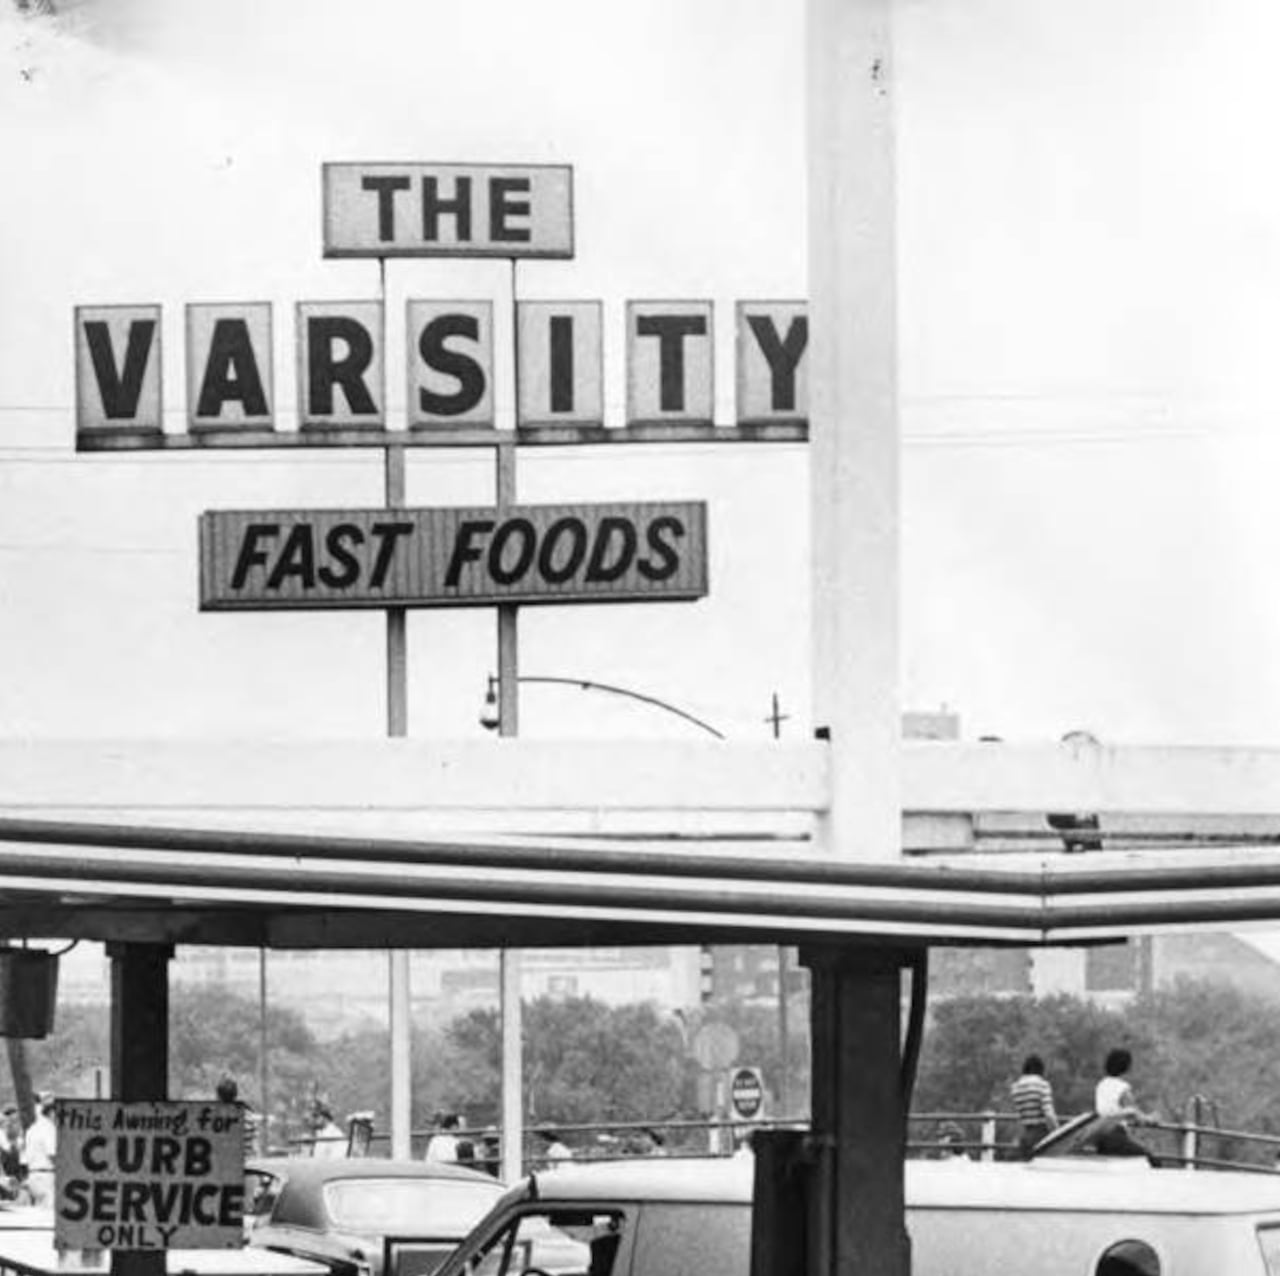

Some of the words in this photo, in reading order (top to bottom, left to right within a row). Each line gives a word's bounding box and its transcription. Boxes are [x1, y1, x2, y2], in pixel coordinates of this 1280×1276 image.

[360, 175, 532, 243] THE
[82, 313, 808, 417] VARSITY
[230, 522, 413, 591] FAST
[444, 516, 684, 588] FOODS
[197, 1106, 240, 1134] for
[81, 1135, 213, 1178] CURB
[60, 1179, 244, 1226] SERVICE
[96, 1225, 178, 1248] ONLY
